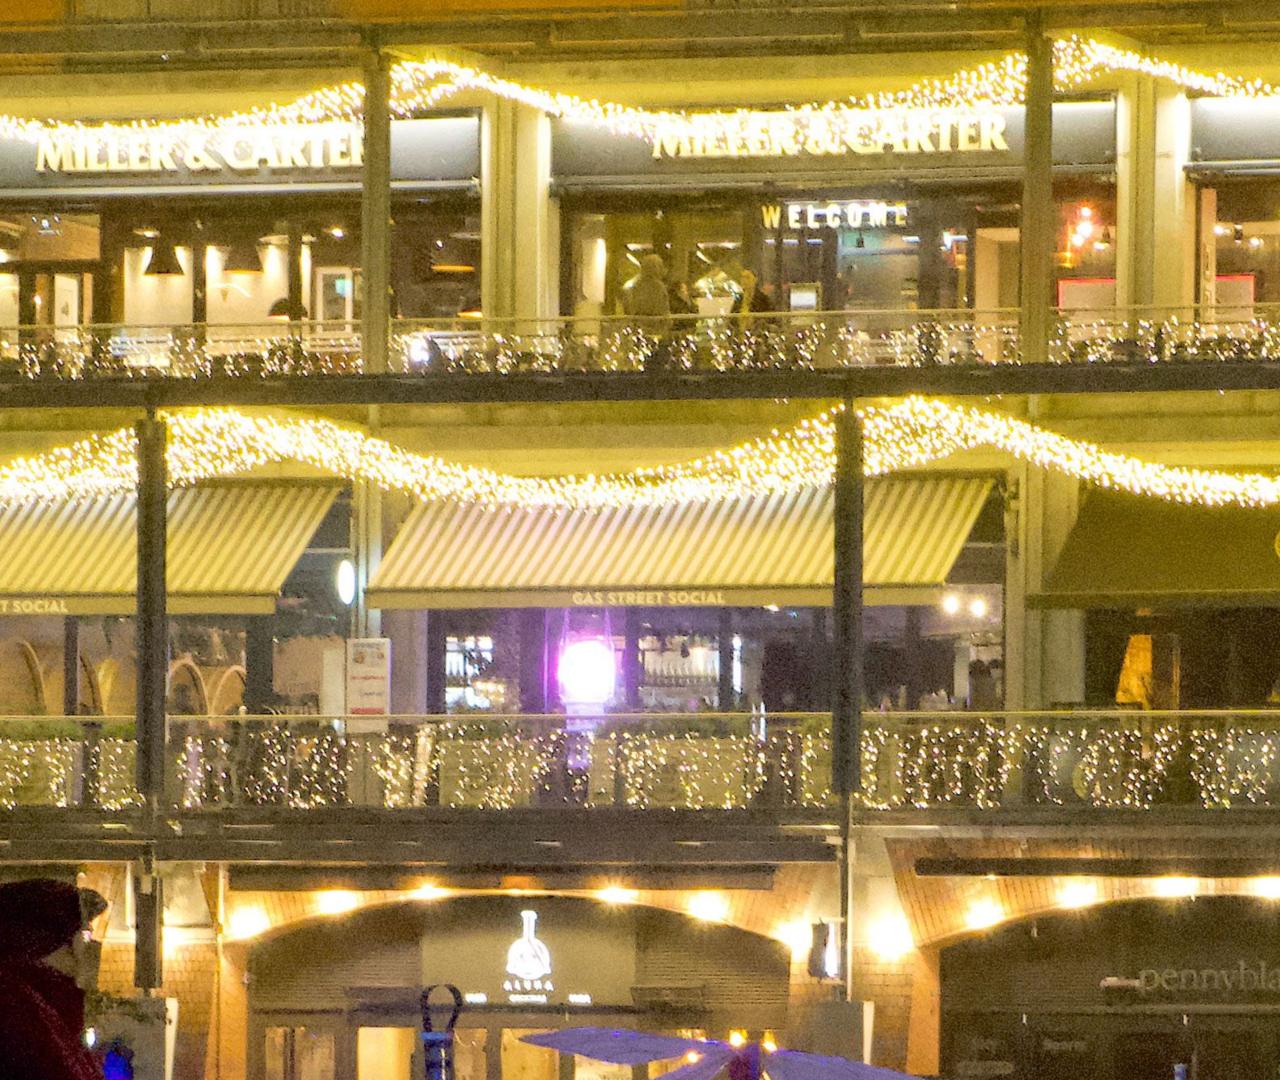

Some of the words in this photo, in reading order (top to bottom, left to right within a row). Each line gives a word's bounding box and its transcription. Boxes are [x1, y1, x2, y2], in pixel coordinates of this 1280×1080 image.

[652, 117, 794, 158] MILLER
[846, 112, 1009, 154] CARTER
[36, 130, 177, 171] MILLER
[761, 203, 908, 230] WELCOME
[13, 600, 69, 613] SOCIAL
[572, 591, 604, 605] GAS
[607, 591, 665, 605] STREET
[668, 591, 726, 604] SOCIAL
